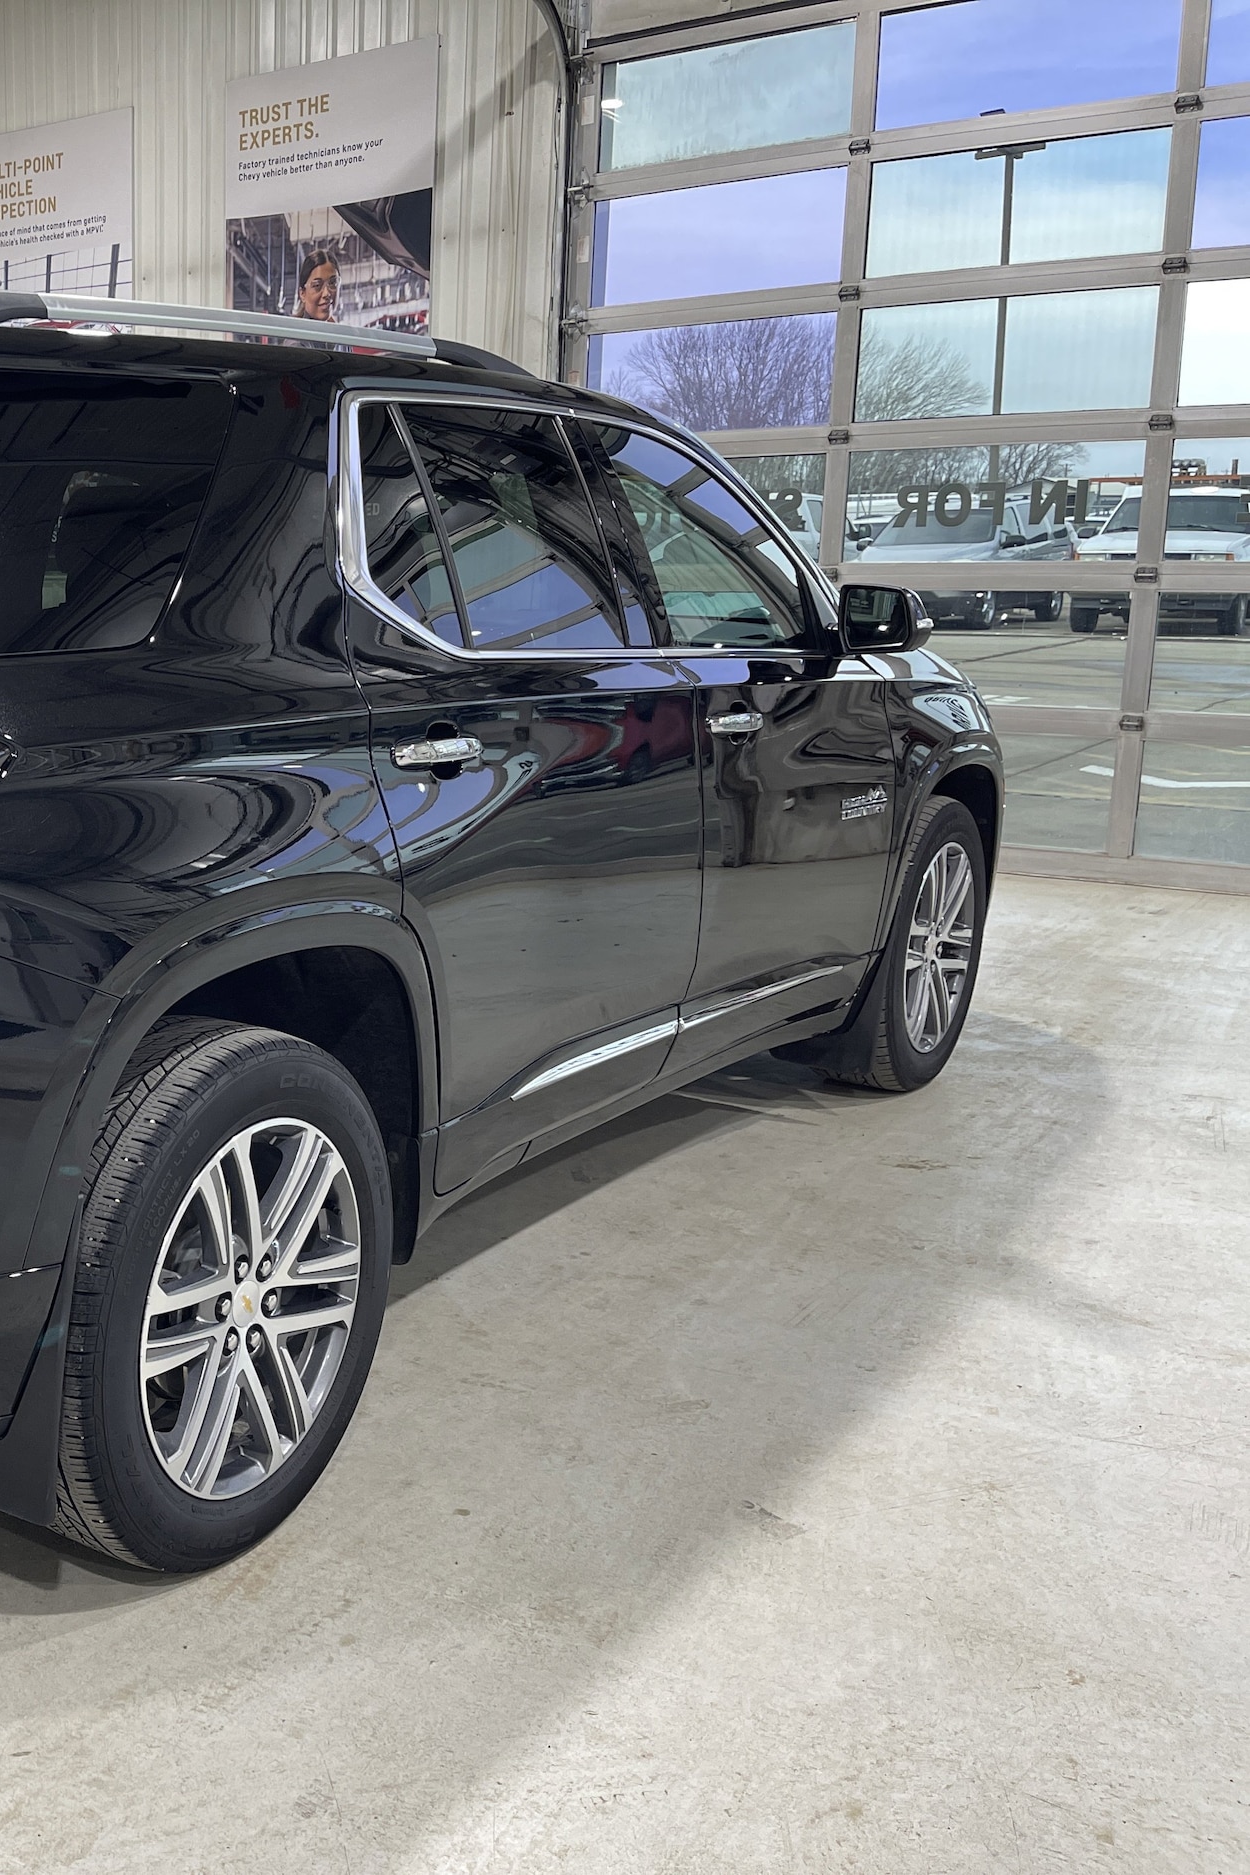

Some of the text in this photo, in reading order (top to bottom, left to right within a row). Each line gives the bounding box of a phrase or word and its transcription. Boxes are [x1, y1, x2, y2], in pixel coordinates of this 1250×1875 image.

[239, 94, 330, 129] TRUST THE
[239, 121, 319, 152] EXPERTS.
[238, 138, 384, 171] Factory trained technicians know your
[238, 155, 365, 182] Chevy vehicle better than anyone.
[9, 228, 16, 236] of
[16, 226, 31, 235] mind
[32, 224, 45, 232] that
[46, 221, 66, 231] comes
[67, 218, 82, 227] from
[83, 215, 107, 227] getting
[19, 235, 39, 245] health
[39, 231, 64, 242] checked
[65, 228, 80, 238] with
